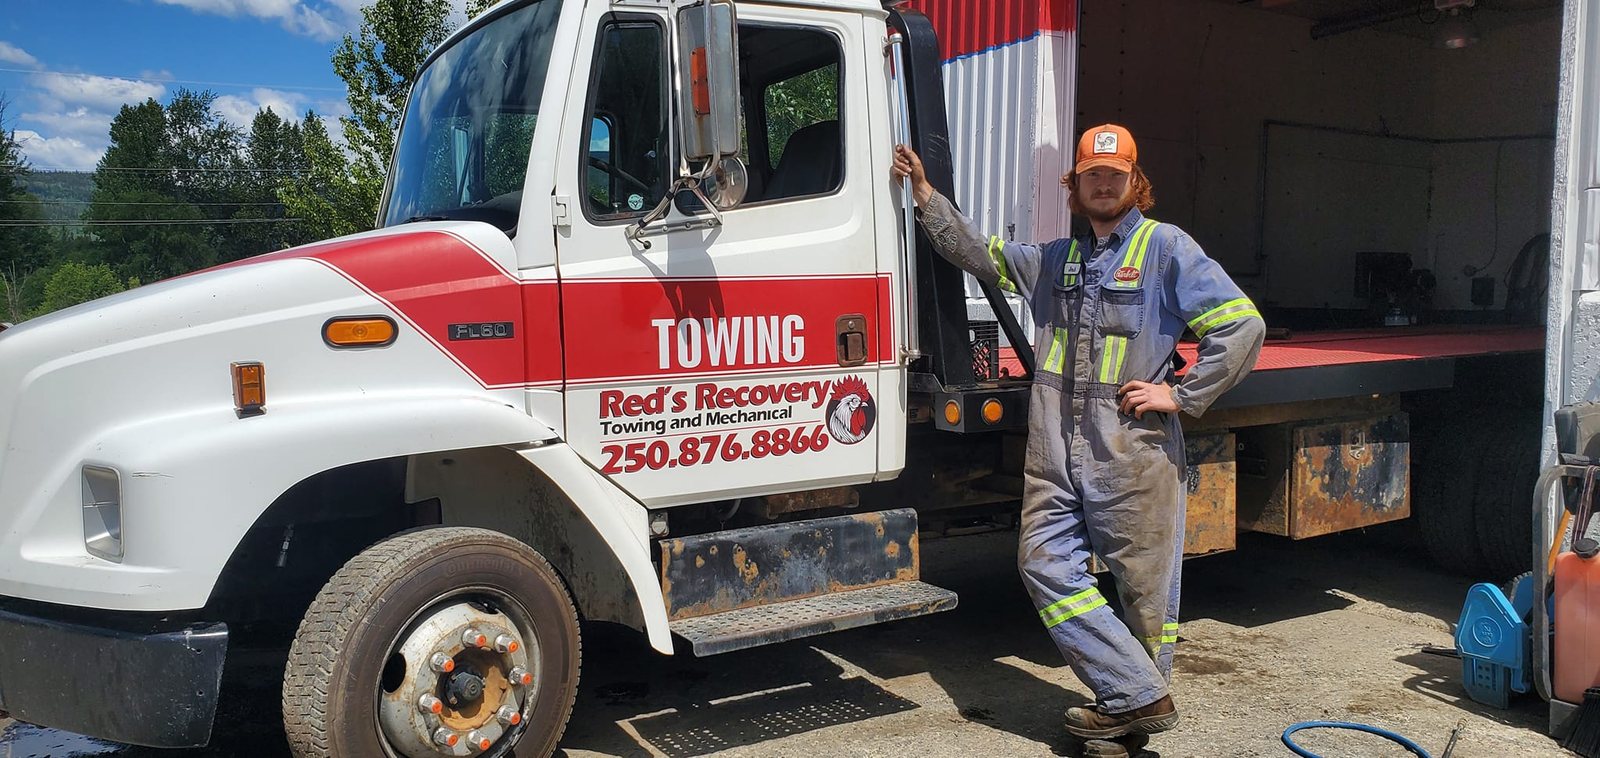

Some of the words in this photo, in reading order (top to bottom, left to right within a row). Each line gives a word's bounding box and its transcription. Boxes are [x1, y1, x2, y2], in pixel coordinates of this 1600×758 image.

[456, 324, 507, 338] FL60
[652, 315, 805, 369] TOWING
[599, 386, 687, 419] Red's
[695, 380, 831, 411] Recovery
[600, 421, 666, 436] Towing
[669, 414, 702, 429] and
[705, 406, 792, 426] Mechanical
[601, 425, 830, 475] 250.876.8866
